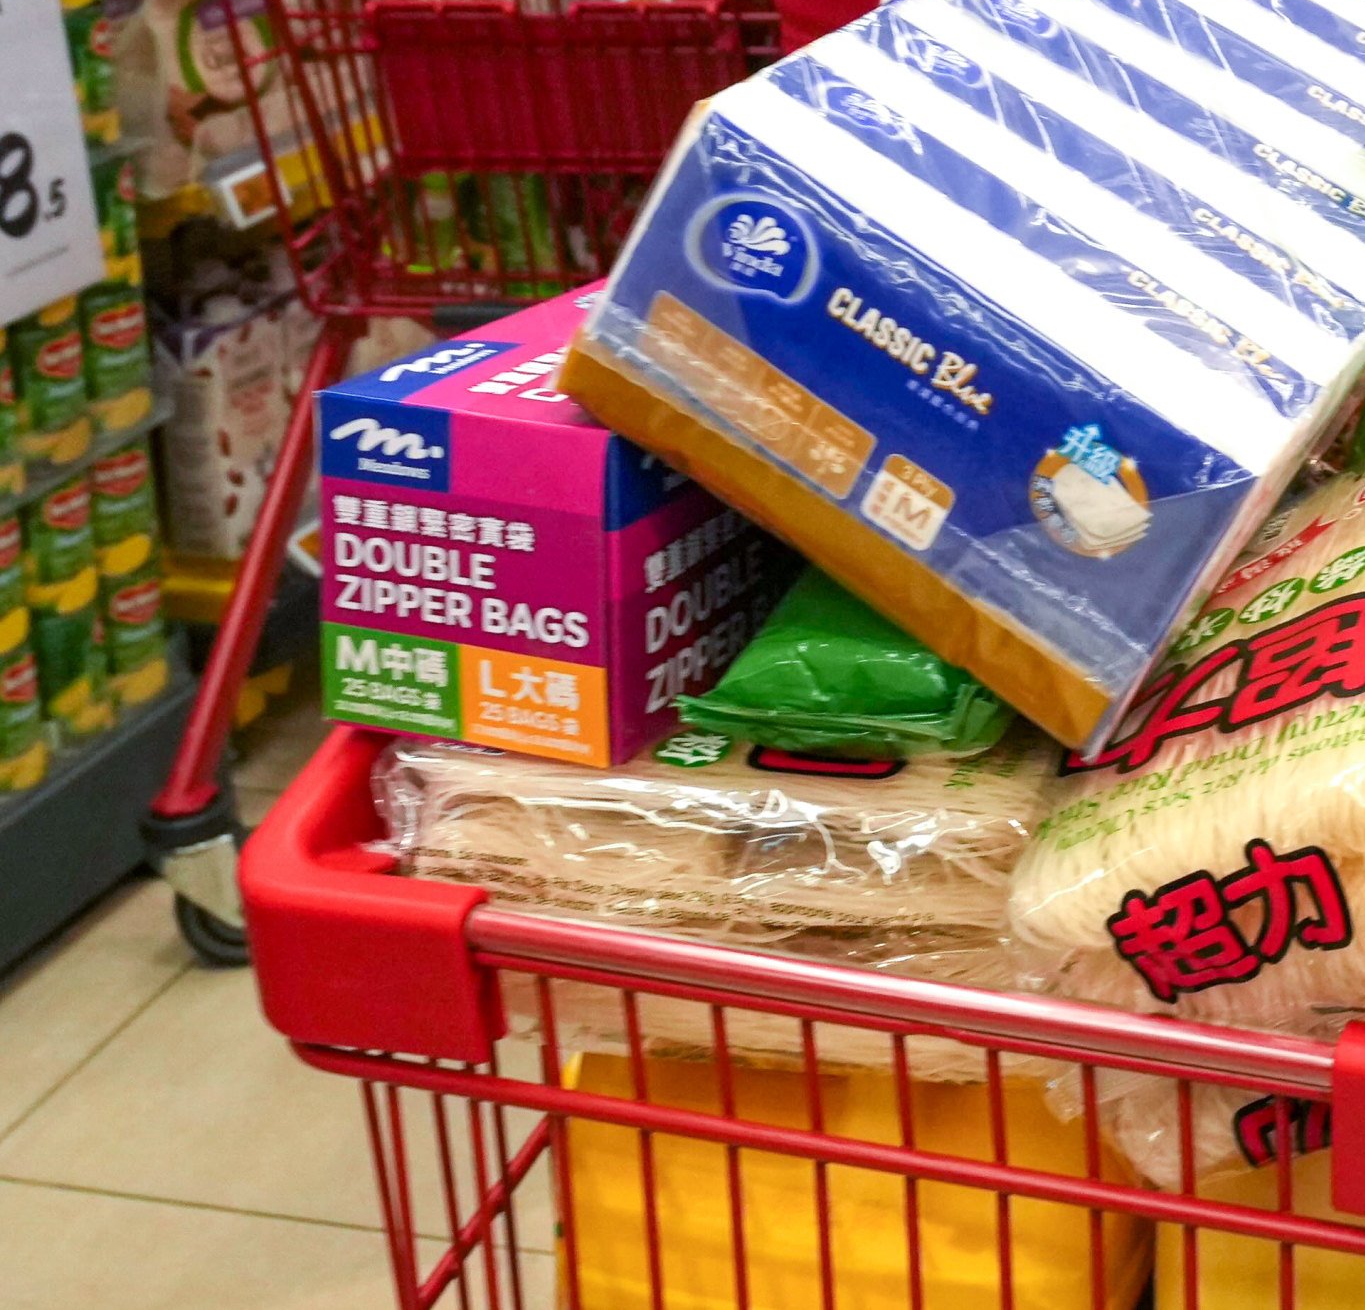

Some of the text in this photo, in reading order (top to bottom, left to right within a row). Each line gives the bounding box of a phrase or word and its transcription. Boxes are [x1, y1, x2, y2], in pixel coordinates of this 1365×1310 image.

[1253, 142, 1346, 203] CLASSIC
[827, 287, 937, 375] CLASSIC
[930, 350, 994, 415] Blue
[334, 531, 497, 590] DOUBLE
[334, 573, 590, 649] ZIPPER BAGS
[645, 540, 765, 654] DOUBLE
[368, 681, 422, 706] BAGS
[506, 705, 559, 730] BAGS
[1106, 836, 1352, 1002] 超力
